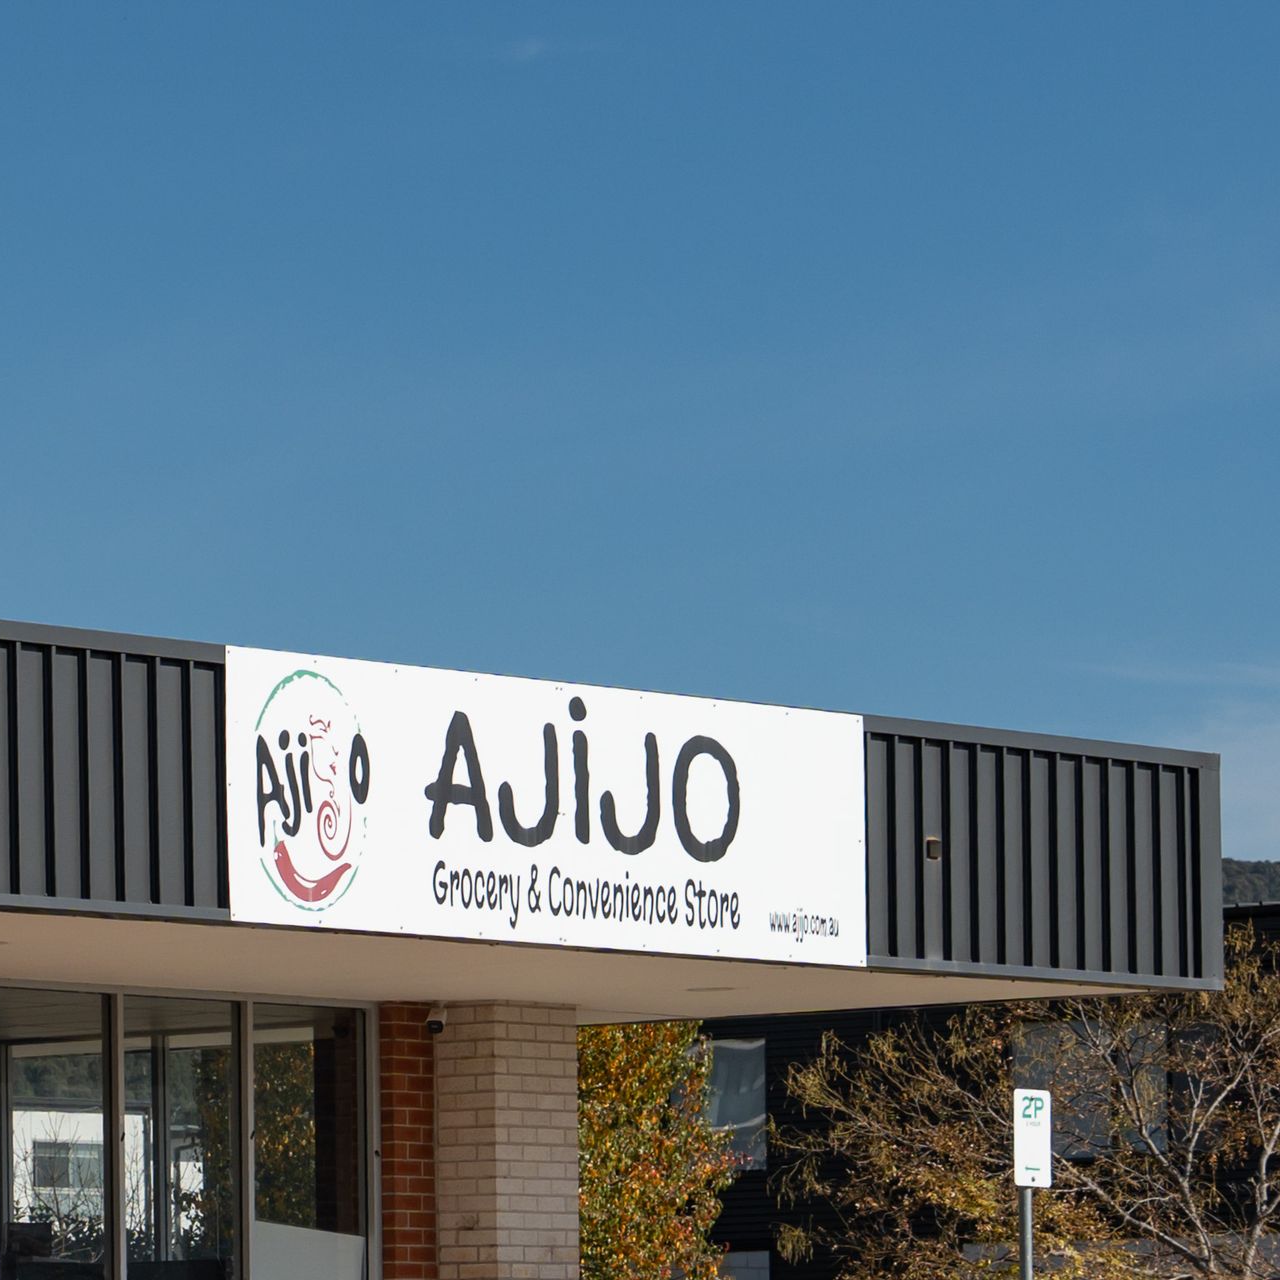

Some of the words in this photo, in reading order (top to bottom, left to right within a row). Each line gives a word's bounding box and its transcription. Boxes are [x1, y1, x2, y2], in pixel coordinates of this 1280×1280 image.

[433, 860, 520, 929] Grocery
[527, 863, 541, 913] &
[548, 866, 678, 925] Convenience
[685, 877, 740, 930] Store
[1022, 1096, 1044, 1119] 2P
